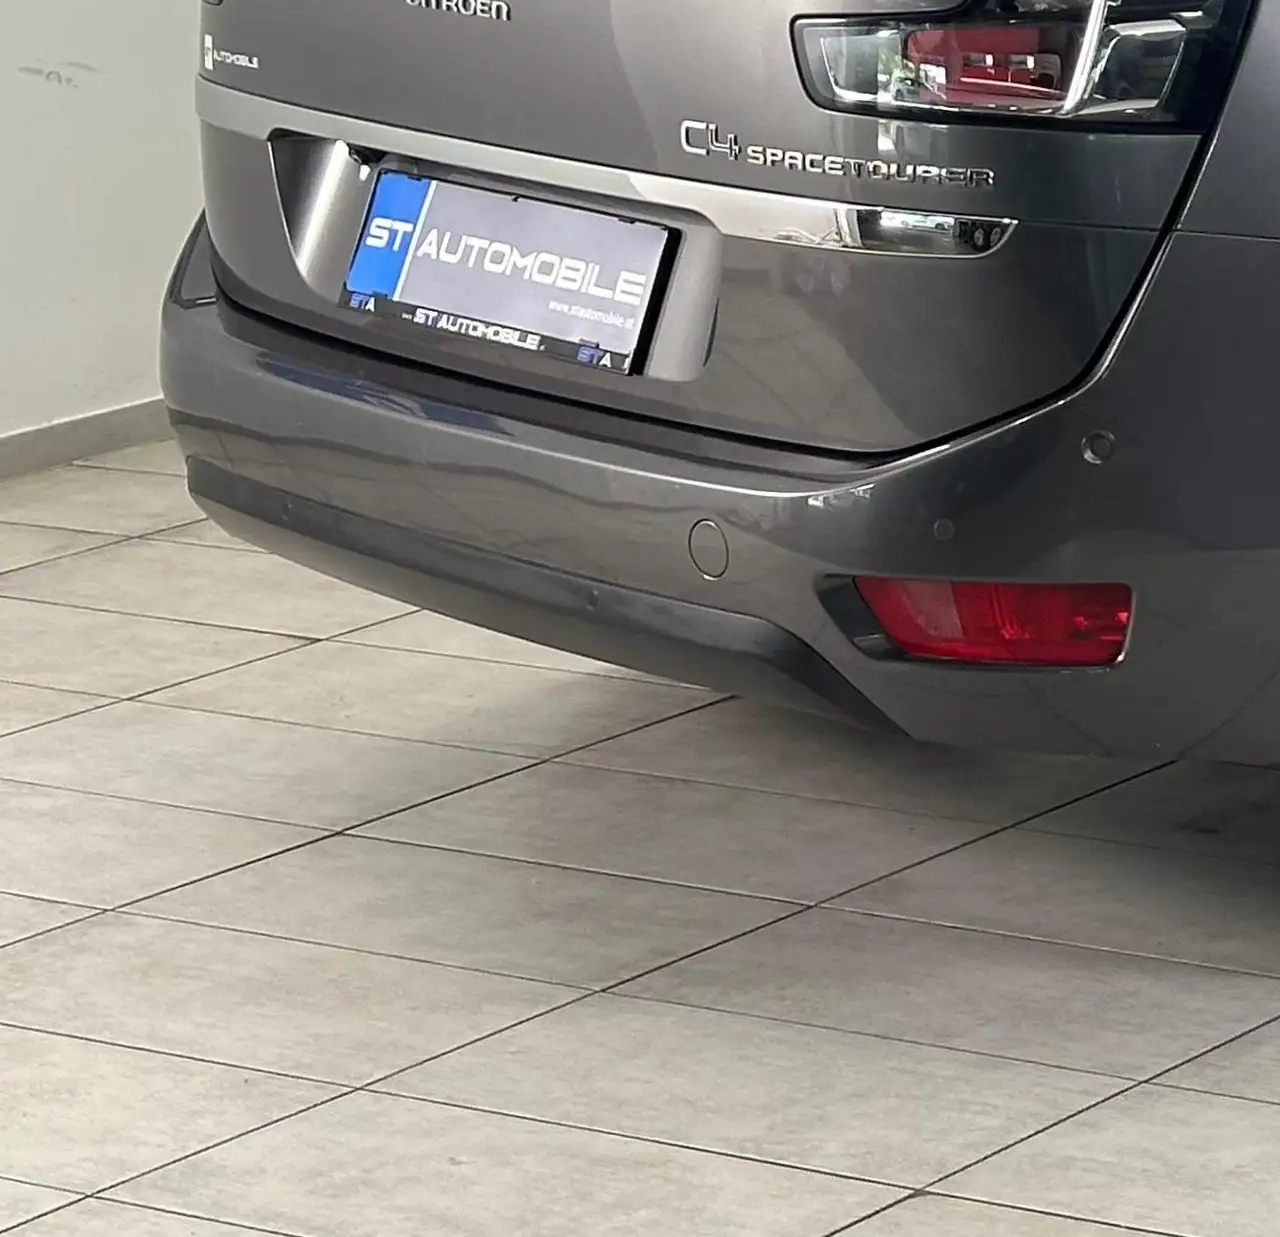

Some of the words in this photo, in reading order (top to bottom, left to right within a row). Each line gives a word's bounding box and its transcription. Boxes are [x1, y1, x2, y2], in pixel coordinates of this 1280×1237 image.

[680, 119, 742, 161] C4
[745, 144, 996, 188] SPACETOURER
[364, 216, 414, 253] ST
[417, 227, 647, 305] AUTOMOBILE
[438, 314, 541, 350] AUTOMOBILE
